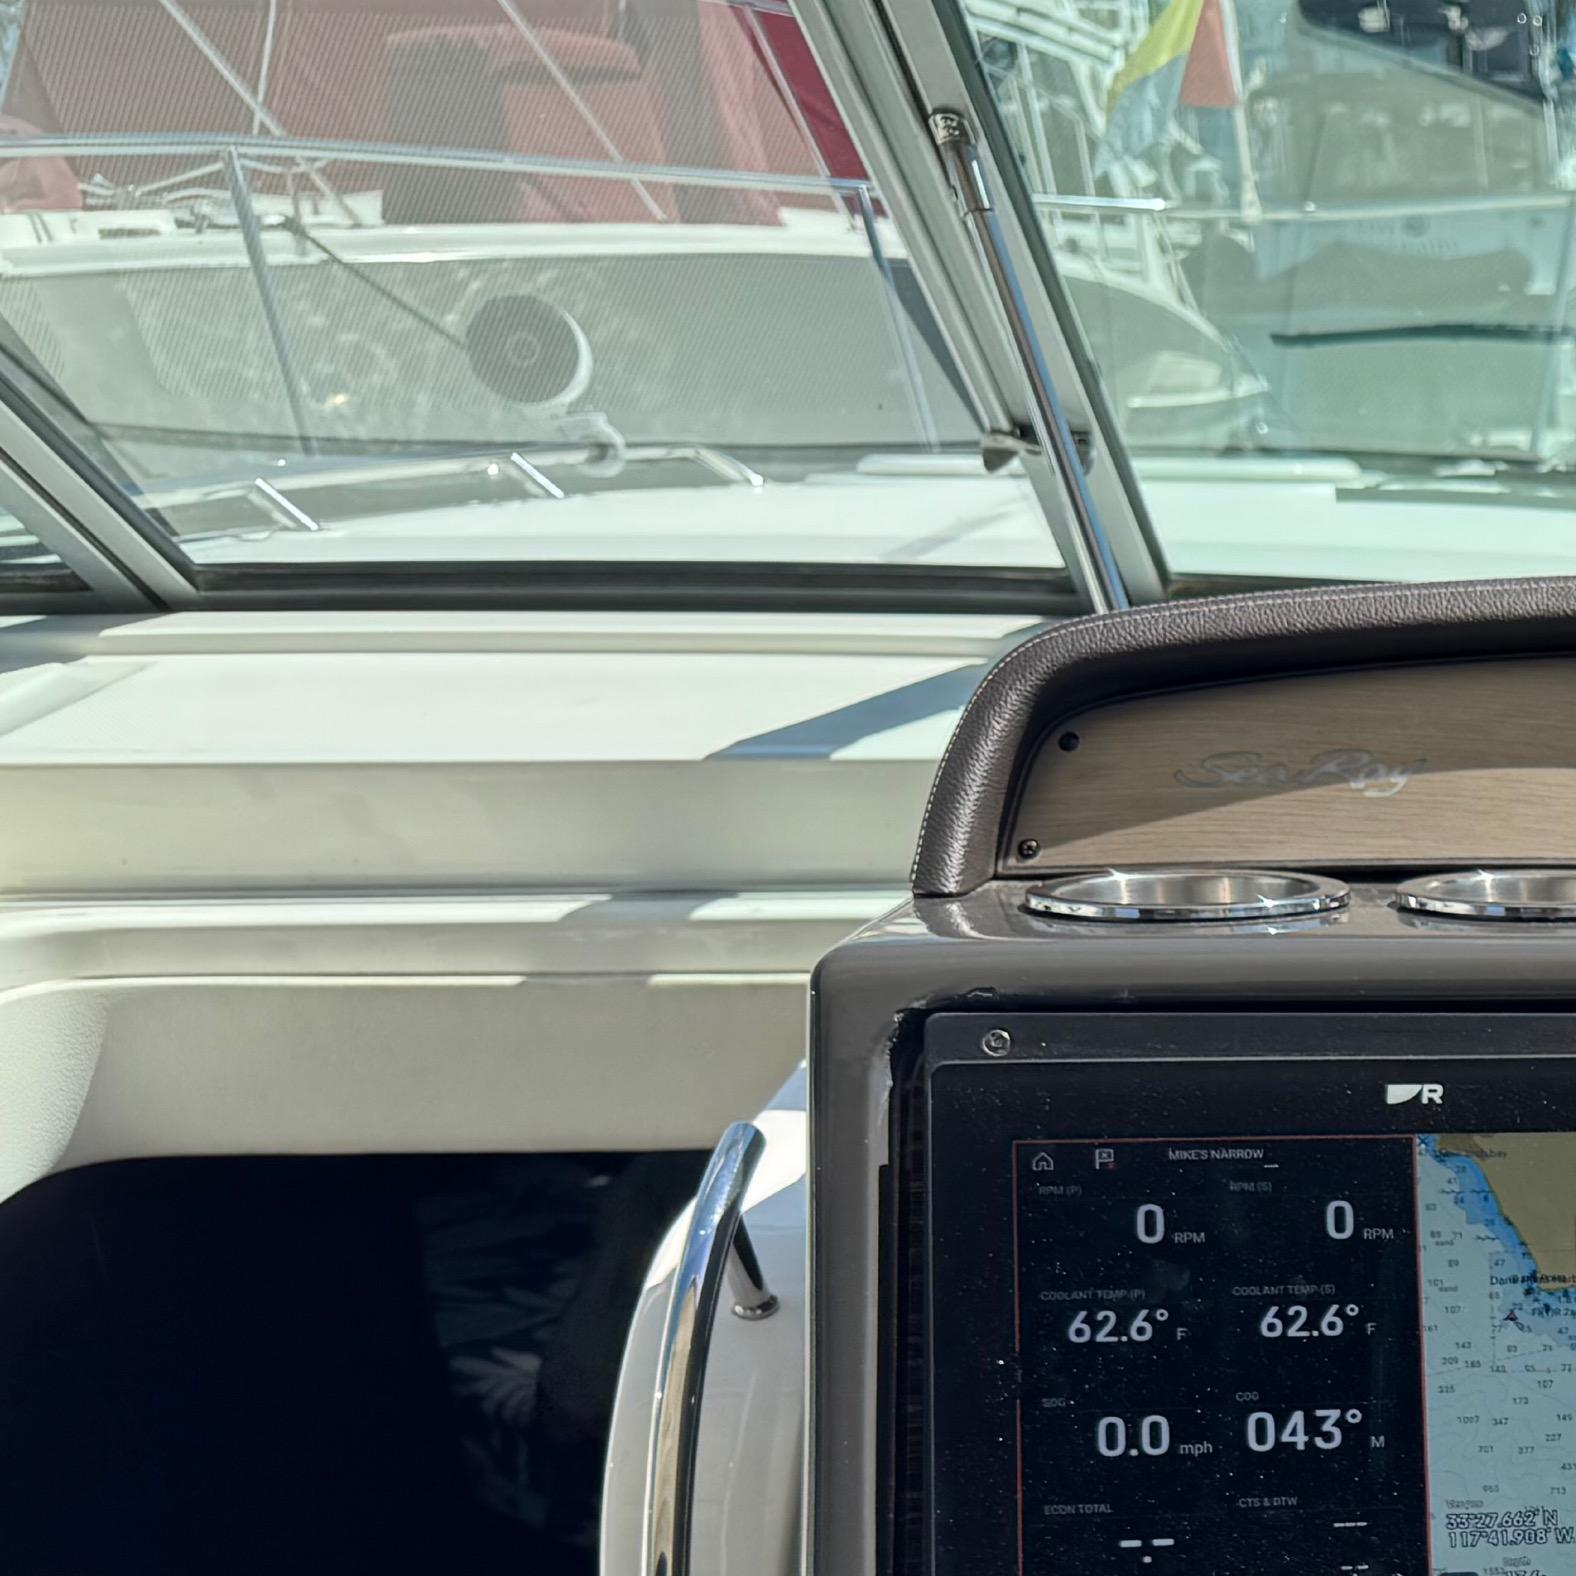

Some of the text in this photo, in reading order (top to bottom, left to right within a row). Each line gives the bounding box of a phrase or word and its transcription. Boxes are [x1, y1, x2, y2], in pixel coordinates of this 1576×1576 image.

[1168, 1148, 1265, 1161] MIKE'S NARROW
[1039, 1184, 1082, 1197] RPM (P)
[1229, 1181, 1255, 1193] RPM
[1136, 1202, 1206, 1245] 0 RPM
[1325, 1199, 1394, 1240] 0 RPM
[1040, 1289, 1094, 1301] COOLANT
[1233, 1285, 1287, 1297] COOLANT
[1068, 1308, 1188, 1344] 62.6° F
[1260, 1303, 1377, 1338] 62.6° F
[1236, 1391, 1260, 1402] COG
[1097, 1414, 1213, 1457] 0.0 mph
[1246, 1407, 1385, 1452] 043° M
[1077, 1502, 1113, 1515] TOTAL
[1237, 1497, 1262, 1509] CTS
[1272, 1496, 1298, 1508] DTW
[1542, 1509, 1559, 1526] N
